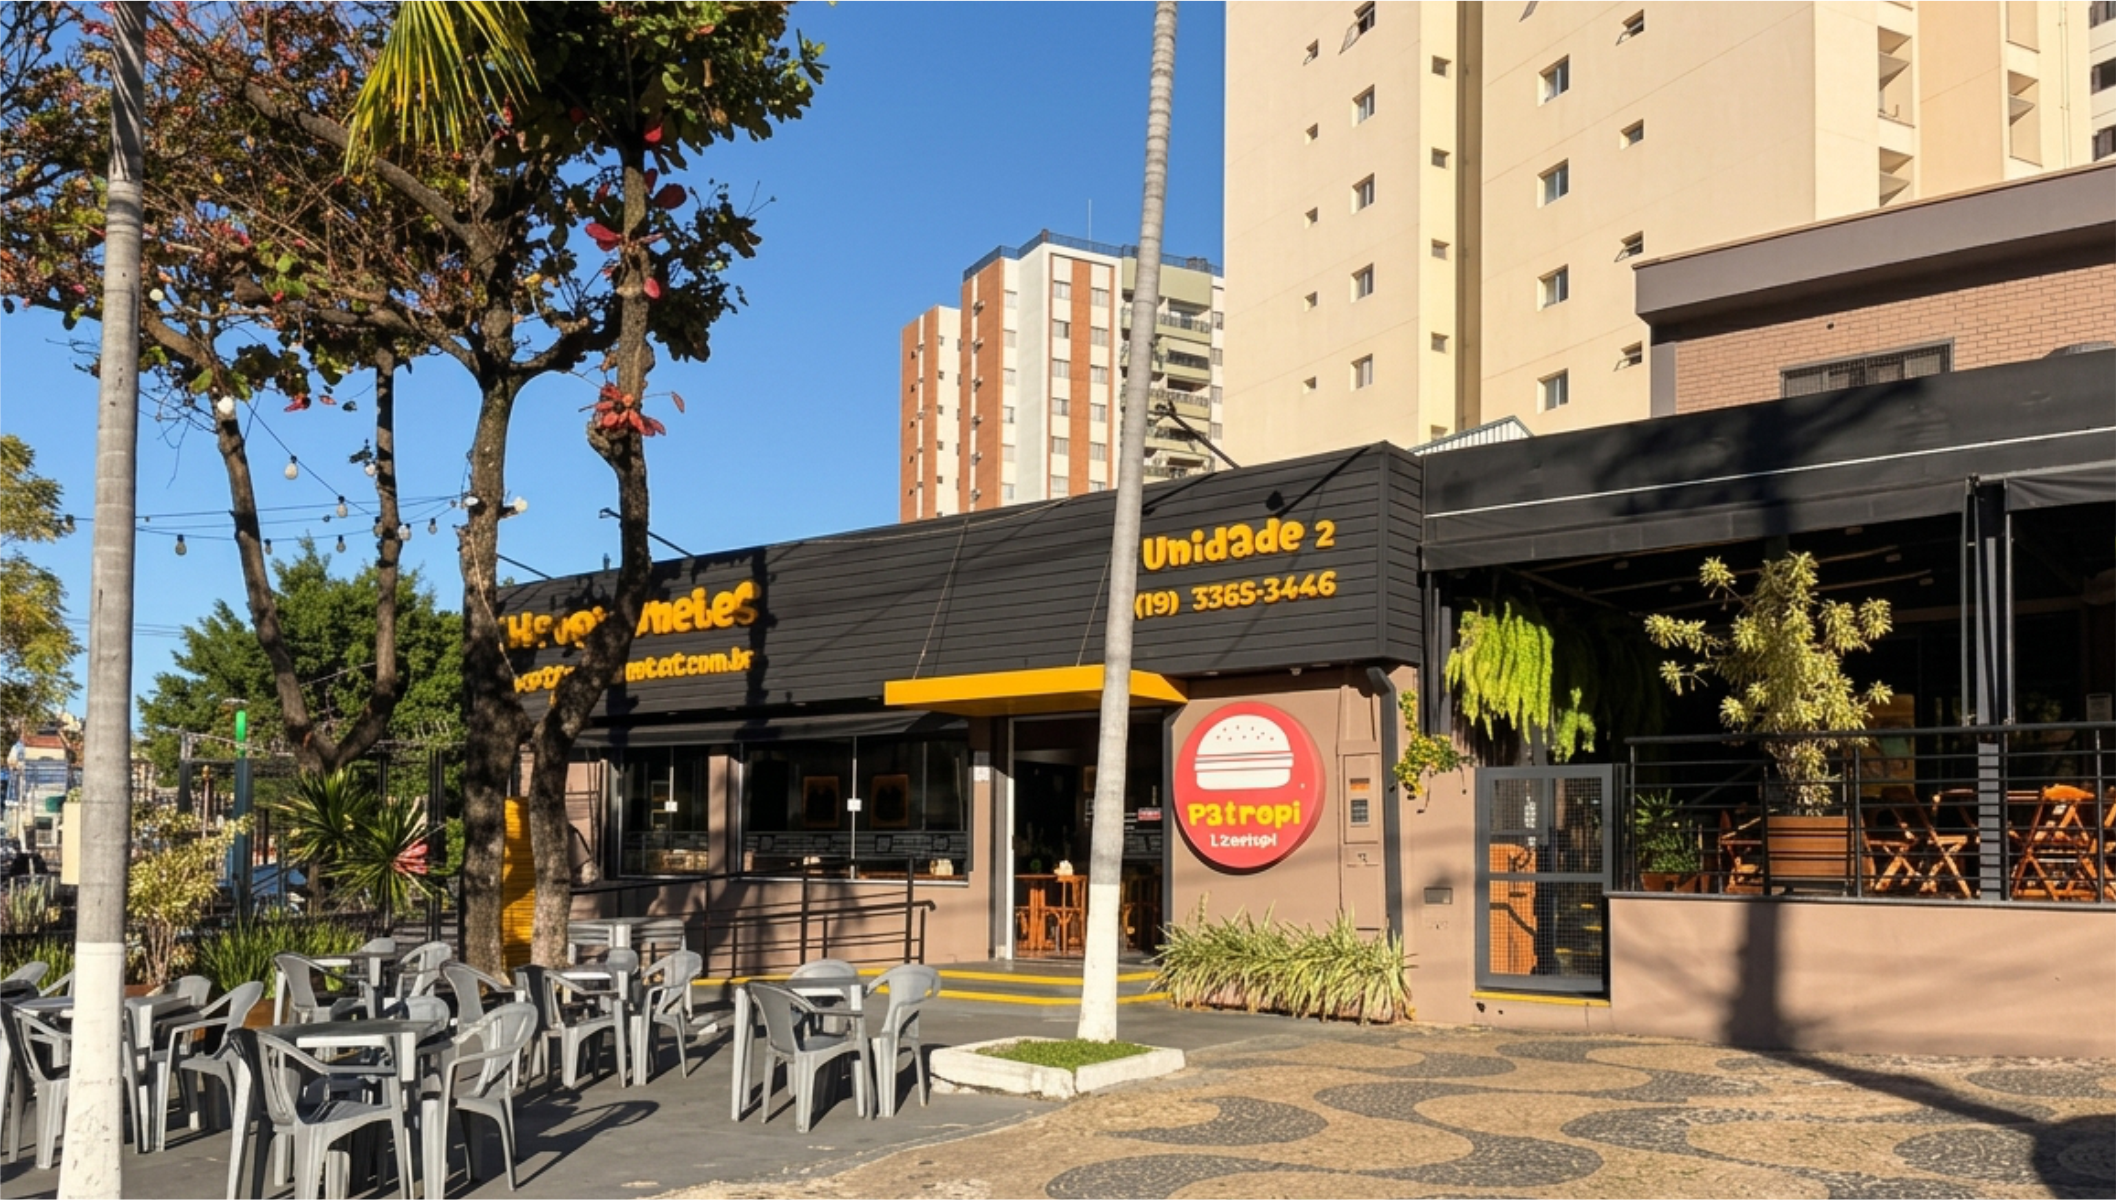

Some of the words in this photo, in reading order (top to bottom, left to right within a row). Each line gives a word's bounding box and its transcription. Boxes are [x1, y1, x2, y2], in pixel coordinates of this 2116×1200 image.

[1142, 517, 1305, 570] Unidade
[1315, 519, 1336, 548] 2
[1134, 590, 1180, 619] (19)
[1190, 570, 1337, 612] 3365-3446
[1187, 800, 1301, 830] Patropi
